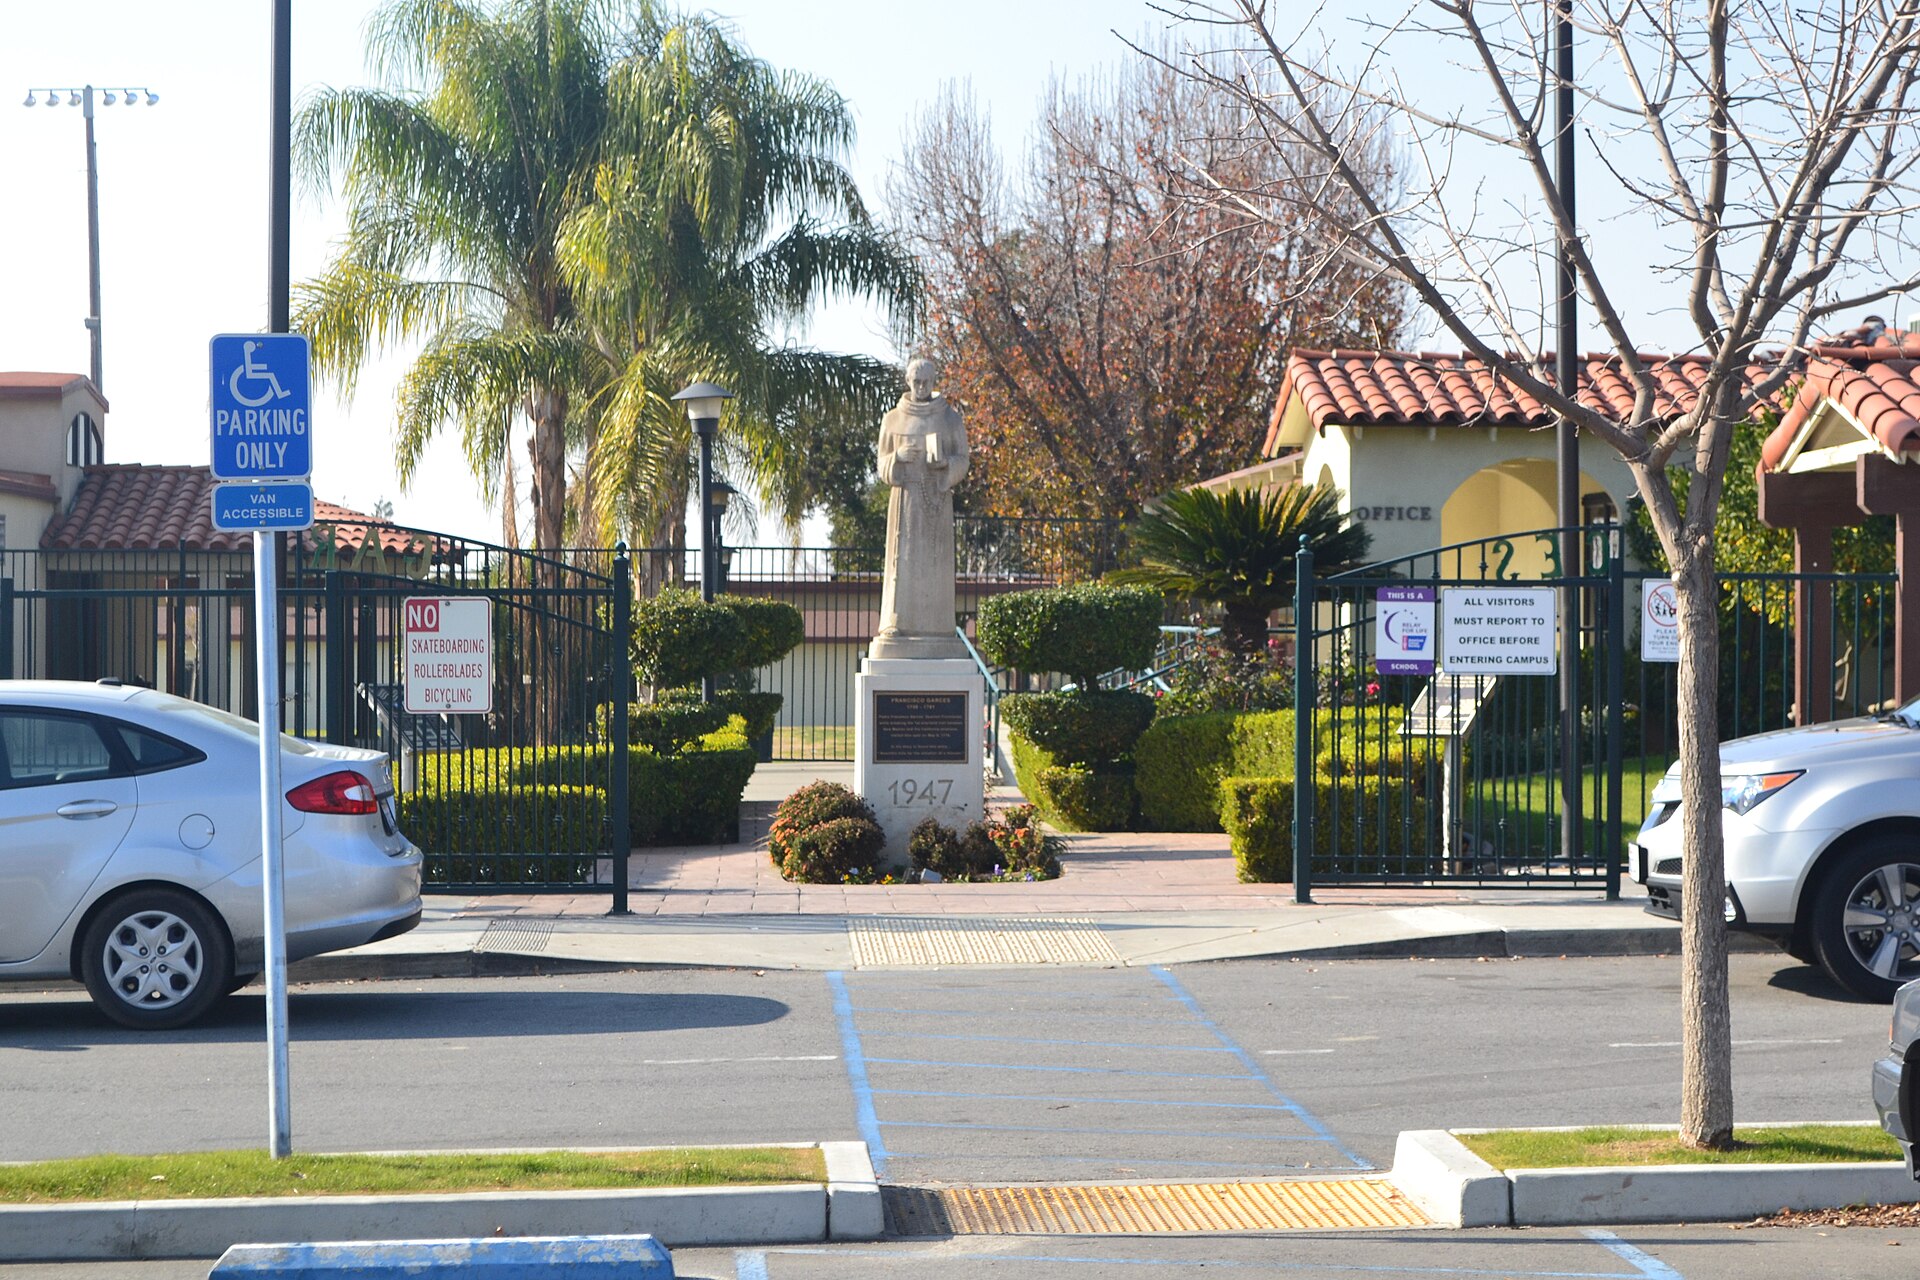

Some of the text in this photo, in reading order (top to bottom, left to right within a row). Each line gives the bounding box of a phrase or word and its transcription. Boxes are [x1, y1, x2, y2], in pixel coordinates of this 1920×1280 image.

[216, 409, 305, 436] PARKING
[235, 441, 288, 469] ONLY
[250, 494, 276, 504] VAN
[222, 508, 304, 520] ACCESSIBLE
[1357, 505, 1432, 521] OFFICE
[1464, 598, 1535, 607] ALL VISITORS
[408, 604, 438, 629] NO
[1453, 617, 1545, 626] MUST REPORT TO
[411, 639, 485, 654] SKATEBOARDING
[1458, 636, 1541, 645] OFFICE BEFORE
[1449, 655, 1549, 664] ENTERING CAMPUS
[414, 663, 483, 679] ROLLERBLADES
[424, 688, 472, 703] BICYCLING
[888, 778, 954, 805] 1947
